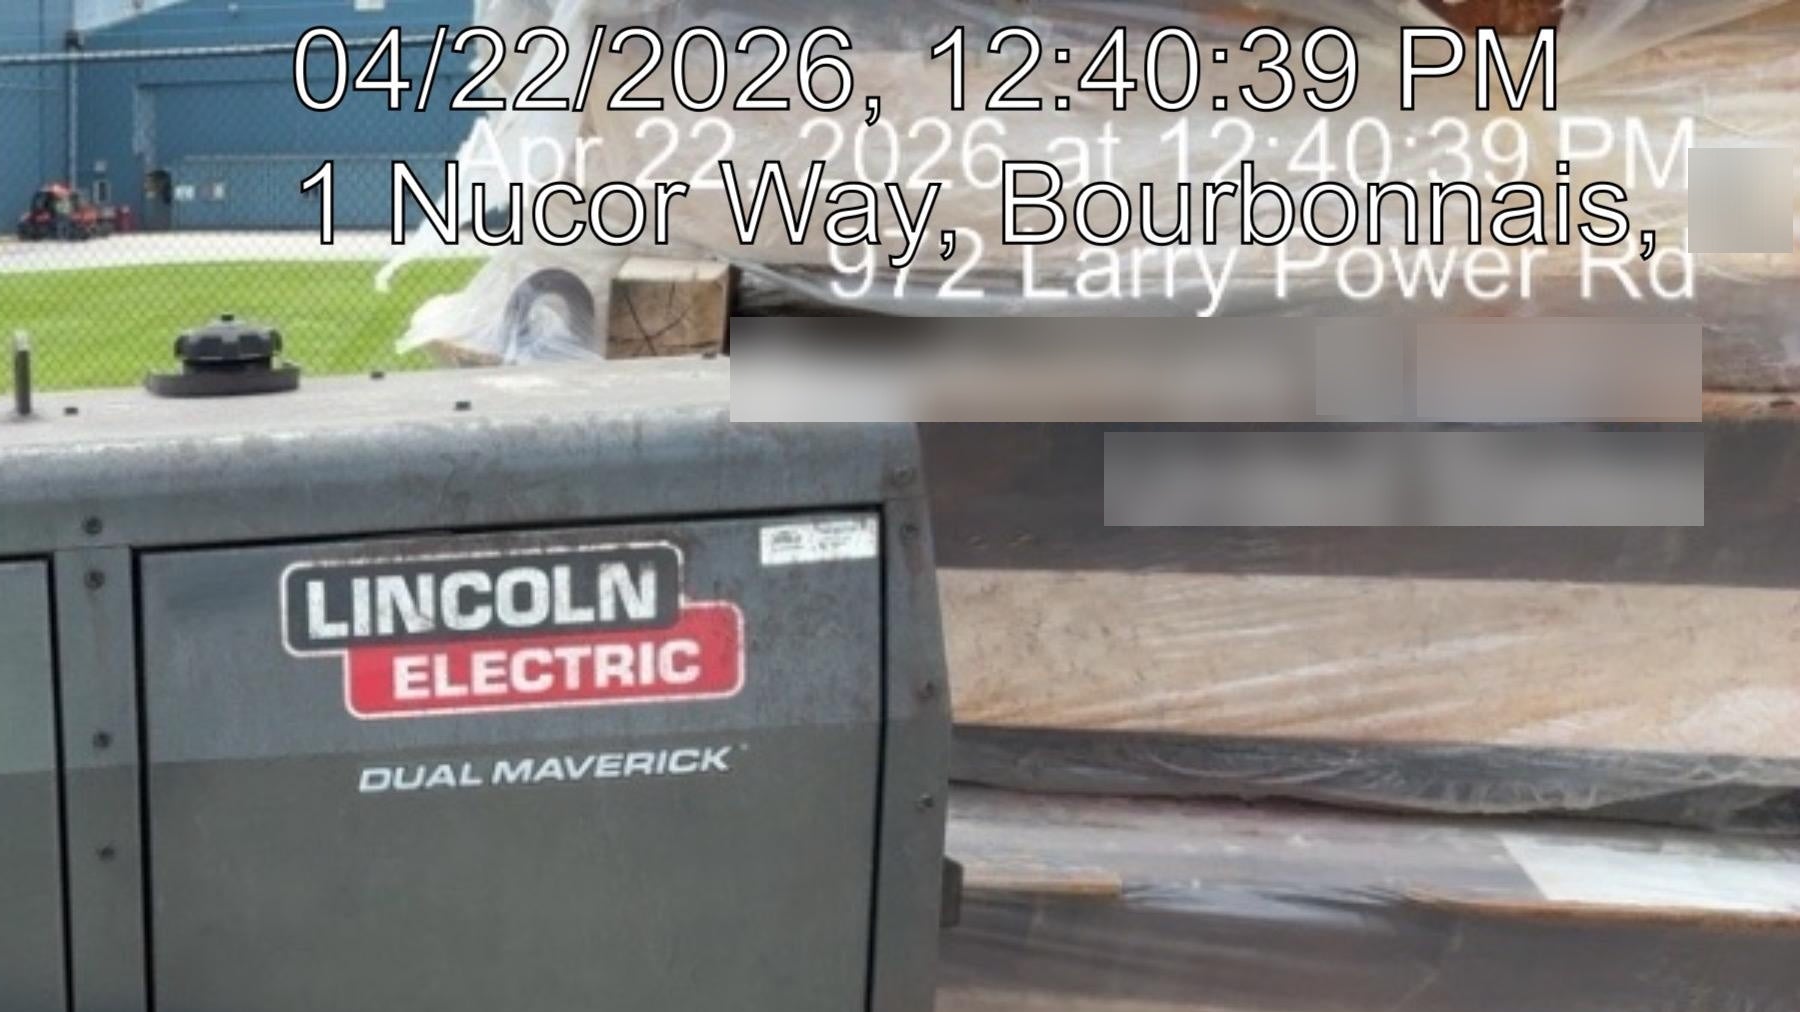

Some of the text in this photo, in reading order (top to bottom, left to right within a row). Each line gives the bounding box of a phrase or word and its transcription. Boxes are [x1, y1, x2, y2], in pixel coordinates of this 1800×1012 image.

[306, 562, 659, 640] LINCOLN
[392, 637, 702, 702] ELECTRIC
[358, 745, 734, 793] DUAL MAVERICK
